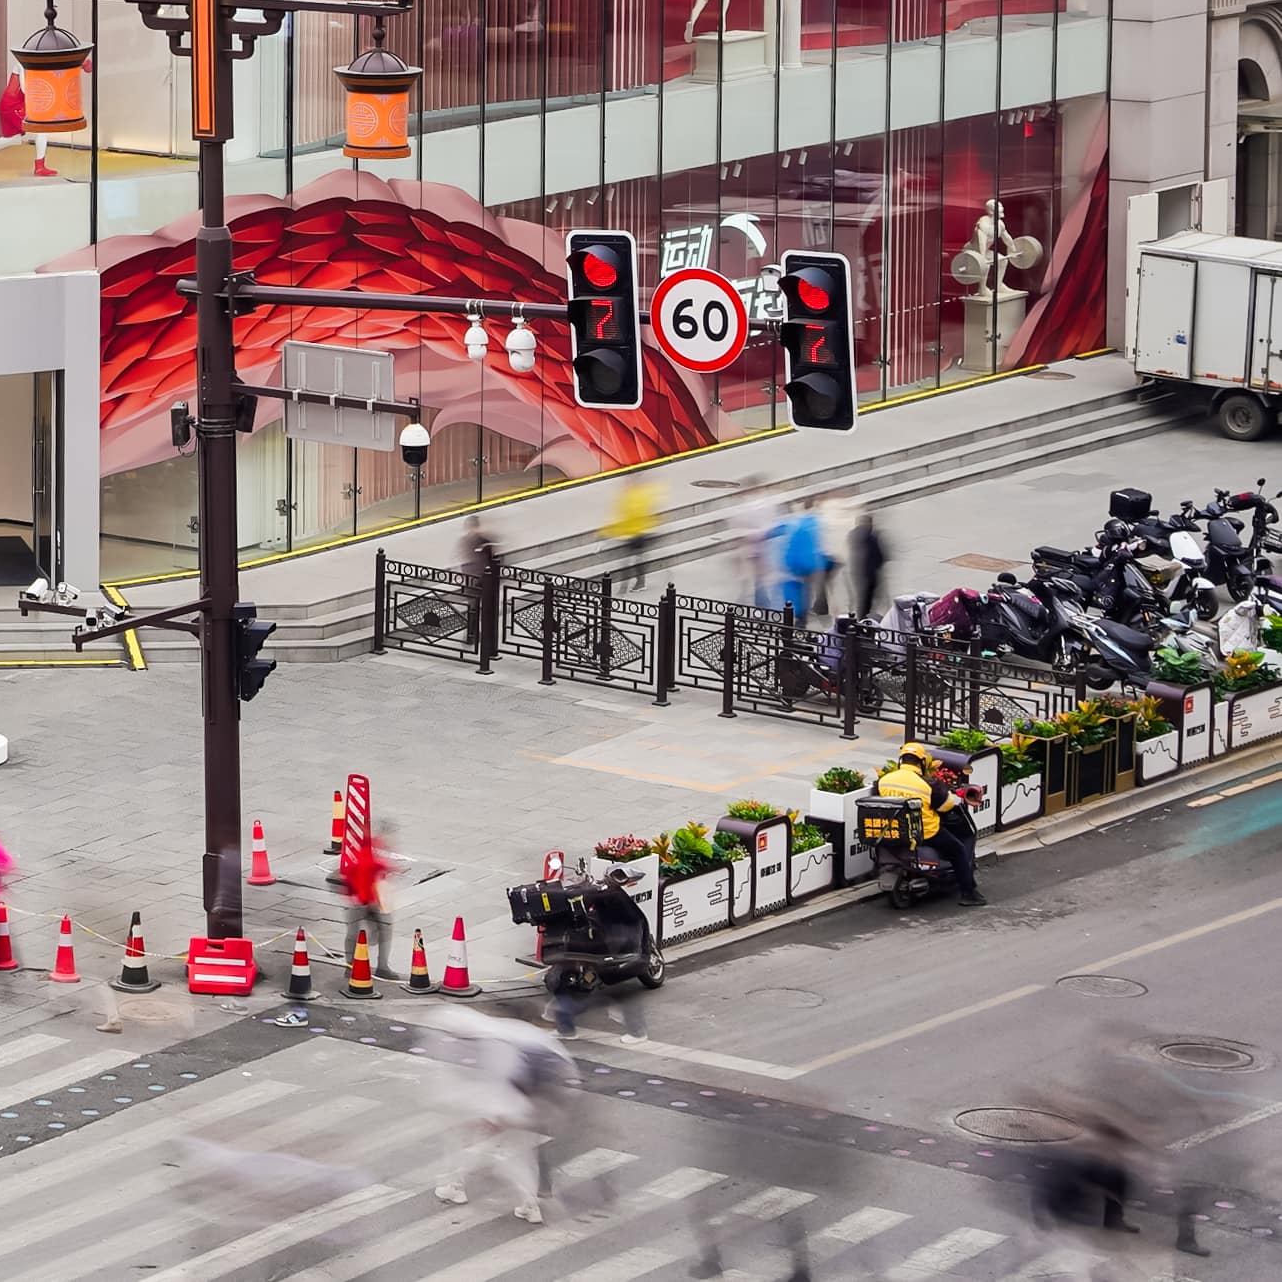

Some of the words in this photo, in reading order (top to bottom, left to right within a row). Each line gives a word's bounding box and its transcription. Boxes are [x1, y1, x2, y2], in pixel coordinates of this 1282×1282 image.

[590, 299, 613, 339] 7
[672, 298, 729, 343] 60
[804, 324, 826, 364] 7
